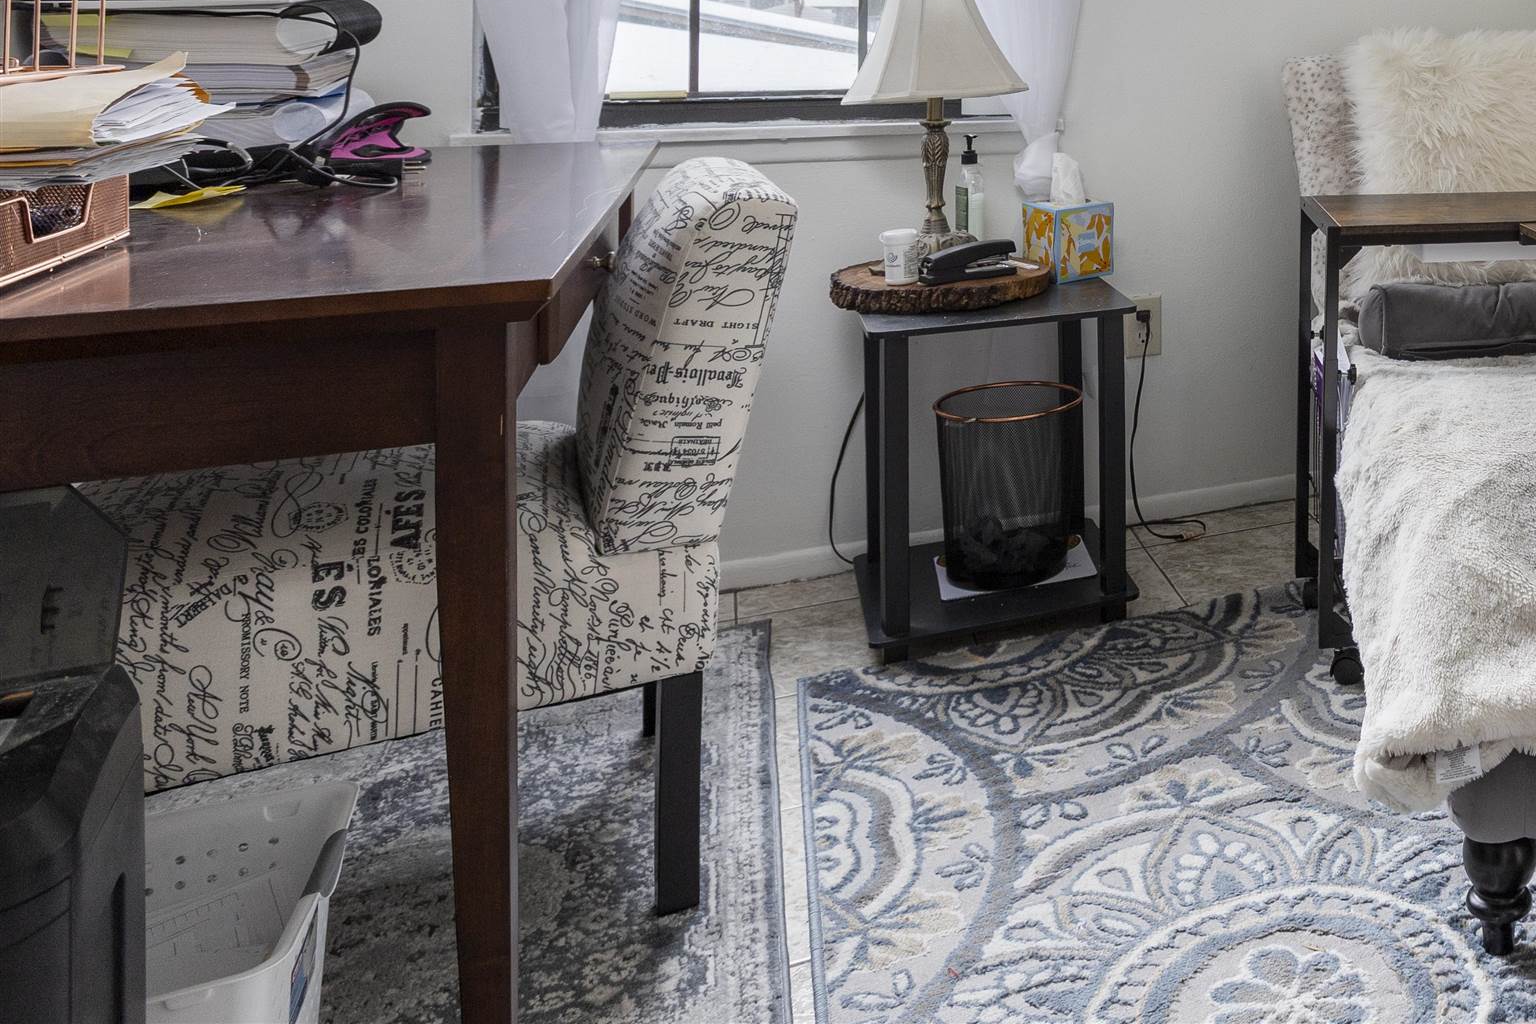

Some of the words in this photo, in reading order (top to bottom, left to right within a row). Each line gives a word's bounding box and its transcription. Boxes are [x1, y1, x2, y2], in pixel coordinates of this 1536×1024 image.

[673, 318, 714, 328] DRAFT
[721, 321, 759, 330] SIGHT
[239, 613, 251, 680] PROMISSORY
[239, 685, 250, 714] NOTE
